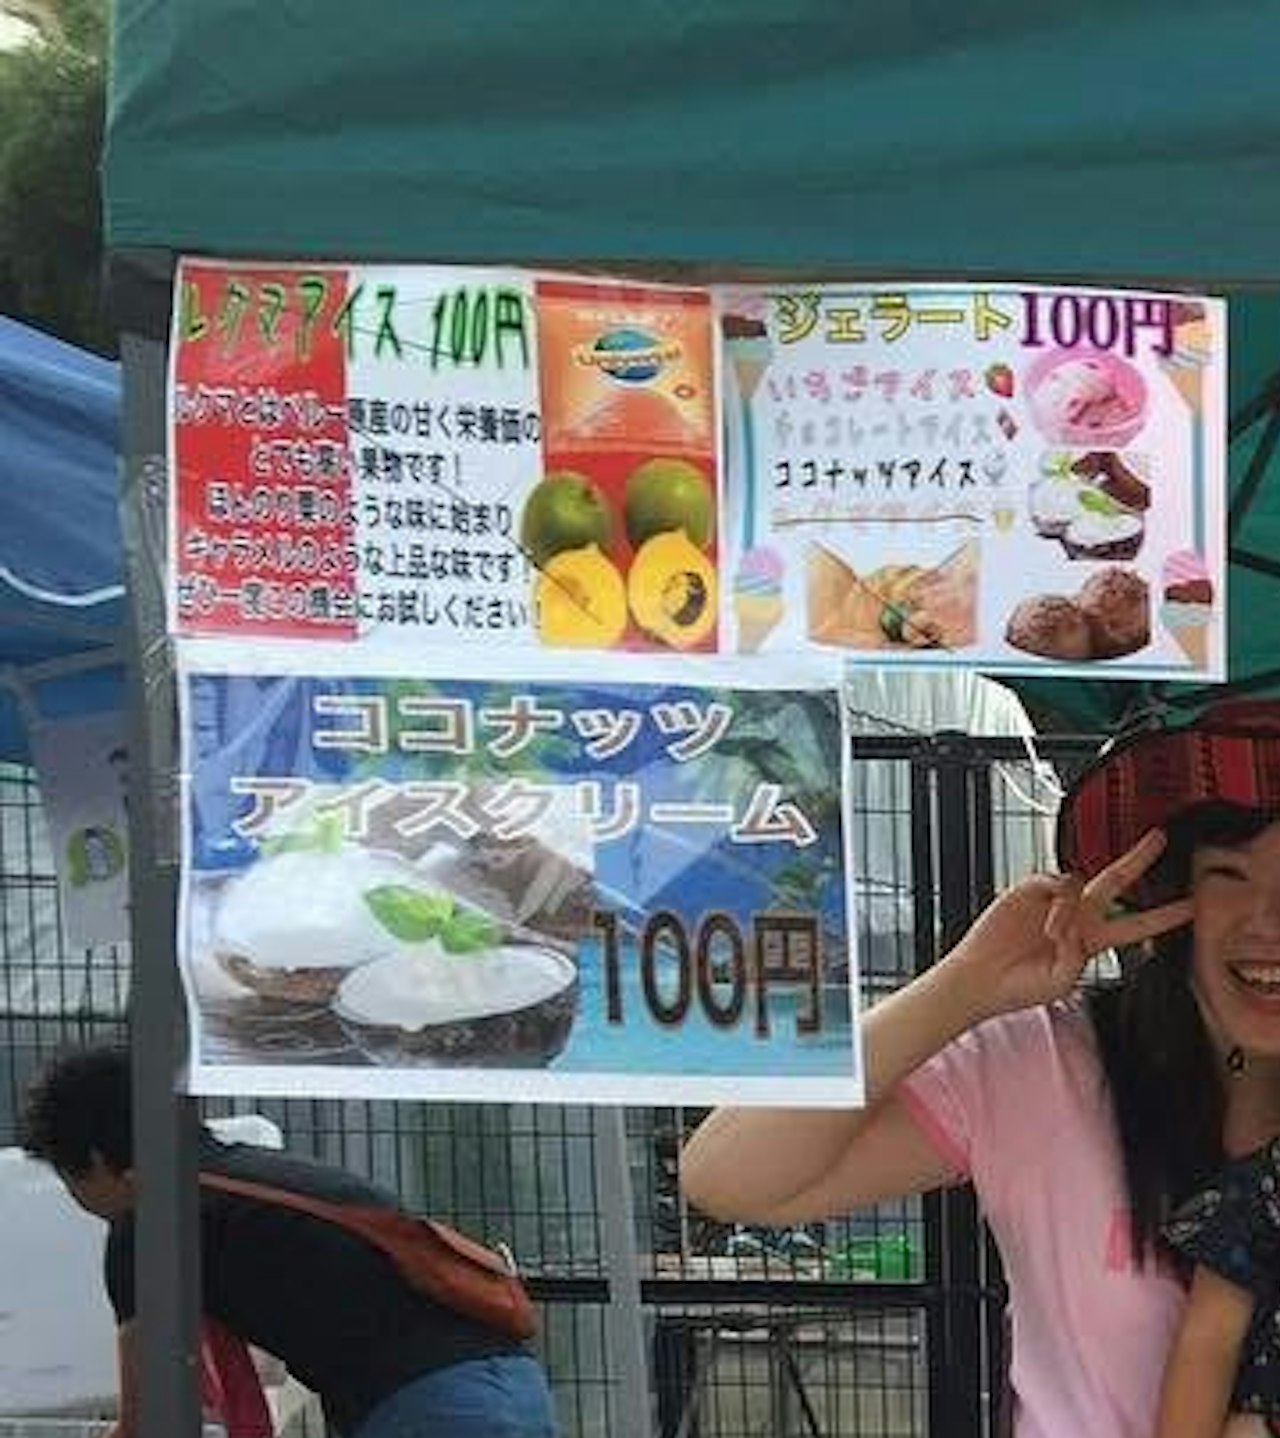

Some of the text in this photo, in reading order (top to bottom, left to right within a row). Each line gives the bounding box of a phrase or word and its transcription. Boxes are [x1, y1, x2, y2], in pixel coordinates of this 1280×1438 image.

[428, 284, 532, 372] 100円
[778, 288, 1174, 357] ジェラート 100円
[774, 458, 978, 490] ココナッツアイス
[308, 692, 735, 764] ココナッツ
[228, 775, 822, 848] アイスクリーム
[590, 906, 824, 1040] 100円
